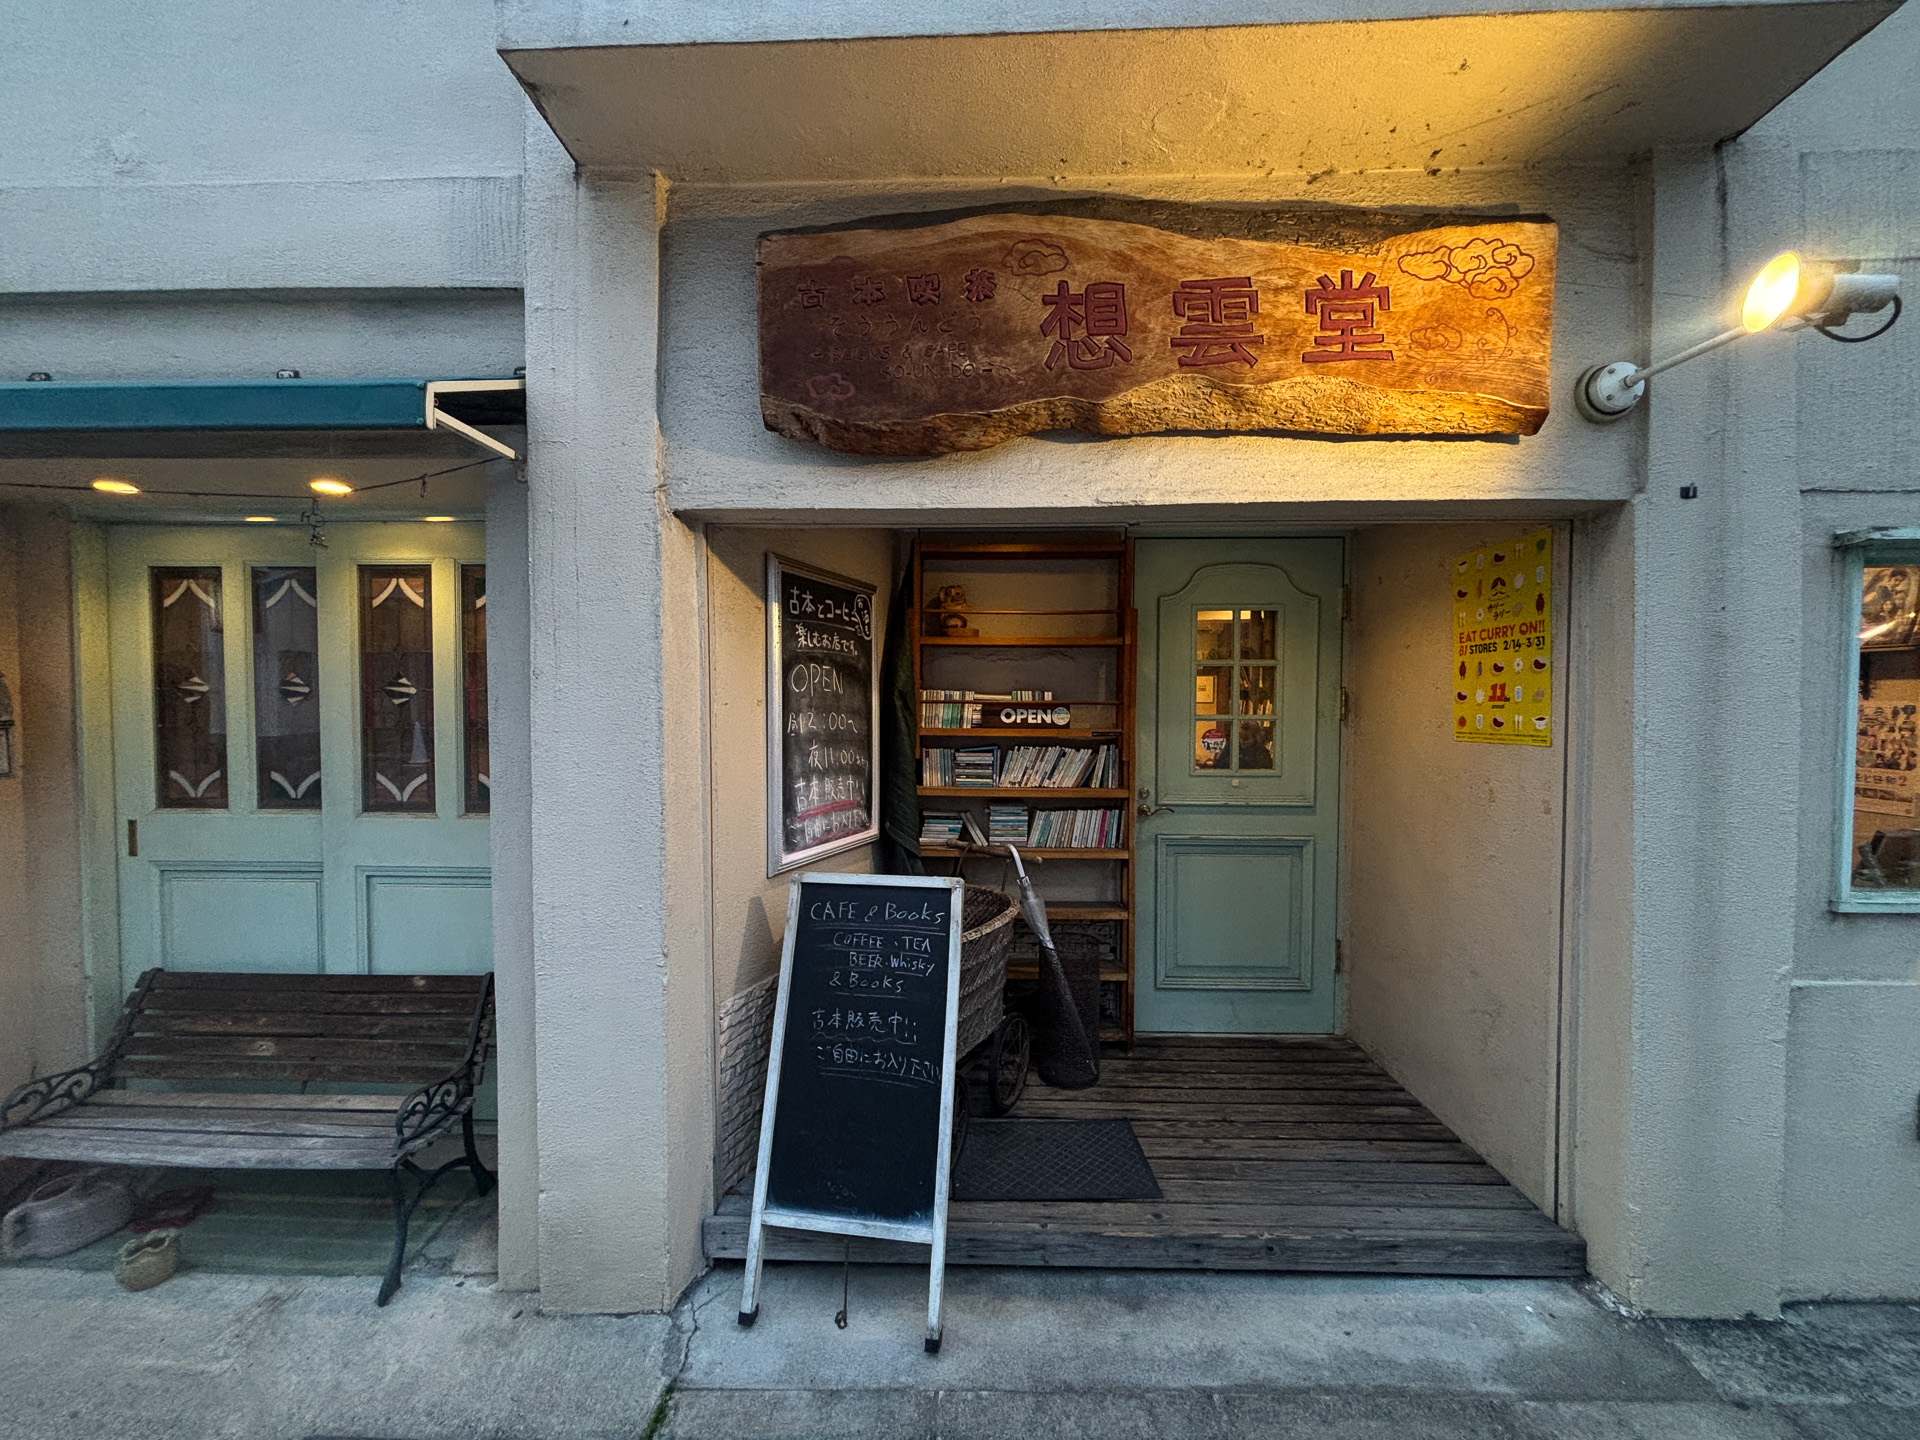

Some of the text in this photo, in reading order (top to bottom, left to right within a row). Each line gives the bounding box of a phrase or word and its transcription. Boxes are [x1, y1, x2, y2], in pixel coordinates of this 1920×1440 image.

[798, 268, 997, 309] 古本喫茶
[1039, 268, 1396, 372] 想雲堂
[902, 345, 913, 359] &
[924, 342, 968, 358] CAFE
[1459, 631, 1477, 644] EAT
[1479, 624, 1516, 641] CURRY
[1469, 642, 1498, 655] STORES
[790, 663, 844, 697] OPEN
[1000, 708, 1051, 724] OPEN
[811, 902, 945, 924] CAFE & Books
[834, 932, 931, 952] COFFEE TEA
[829, 972, 904, 993] & Books
